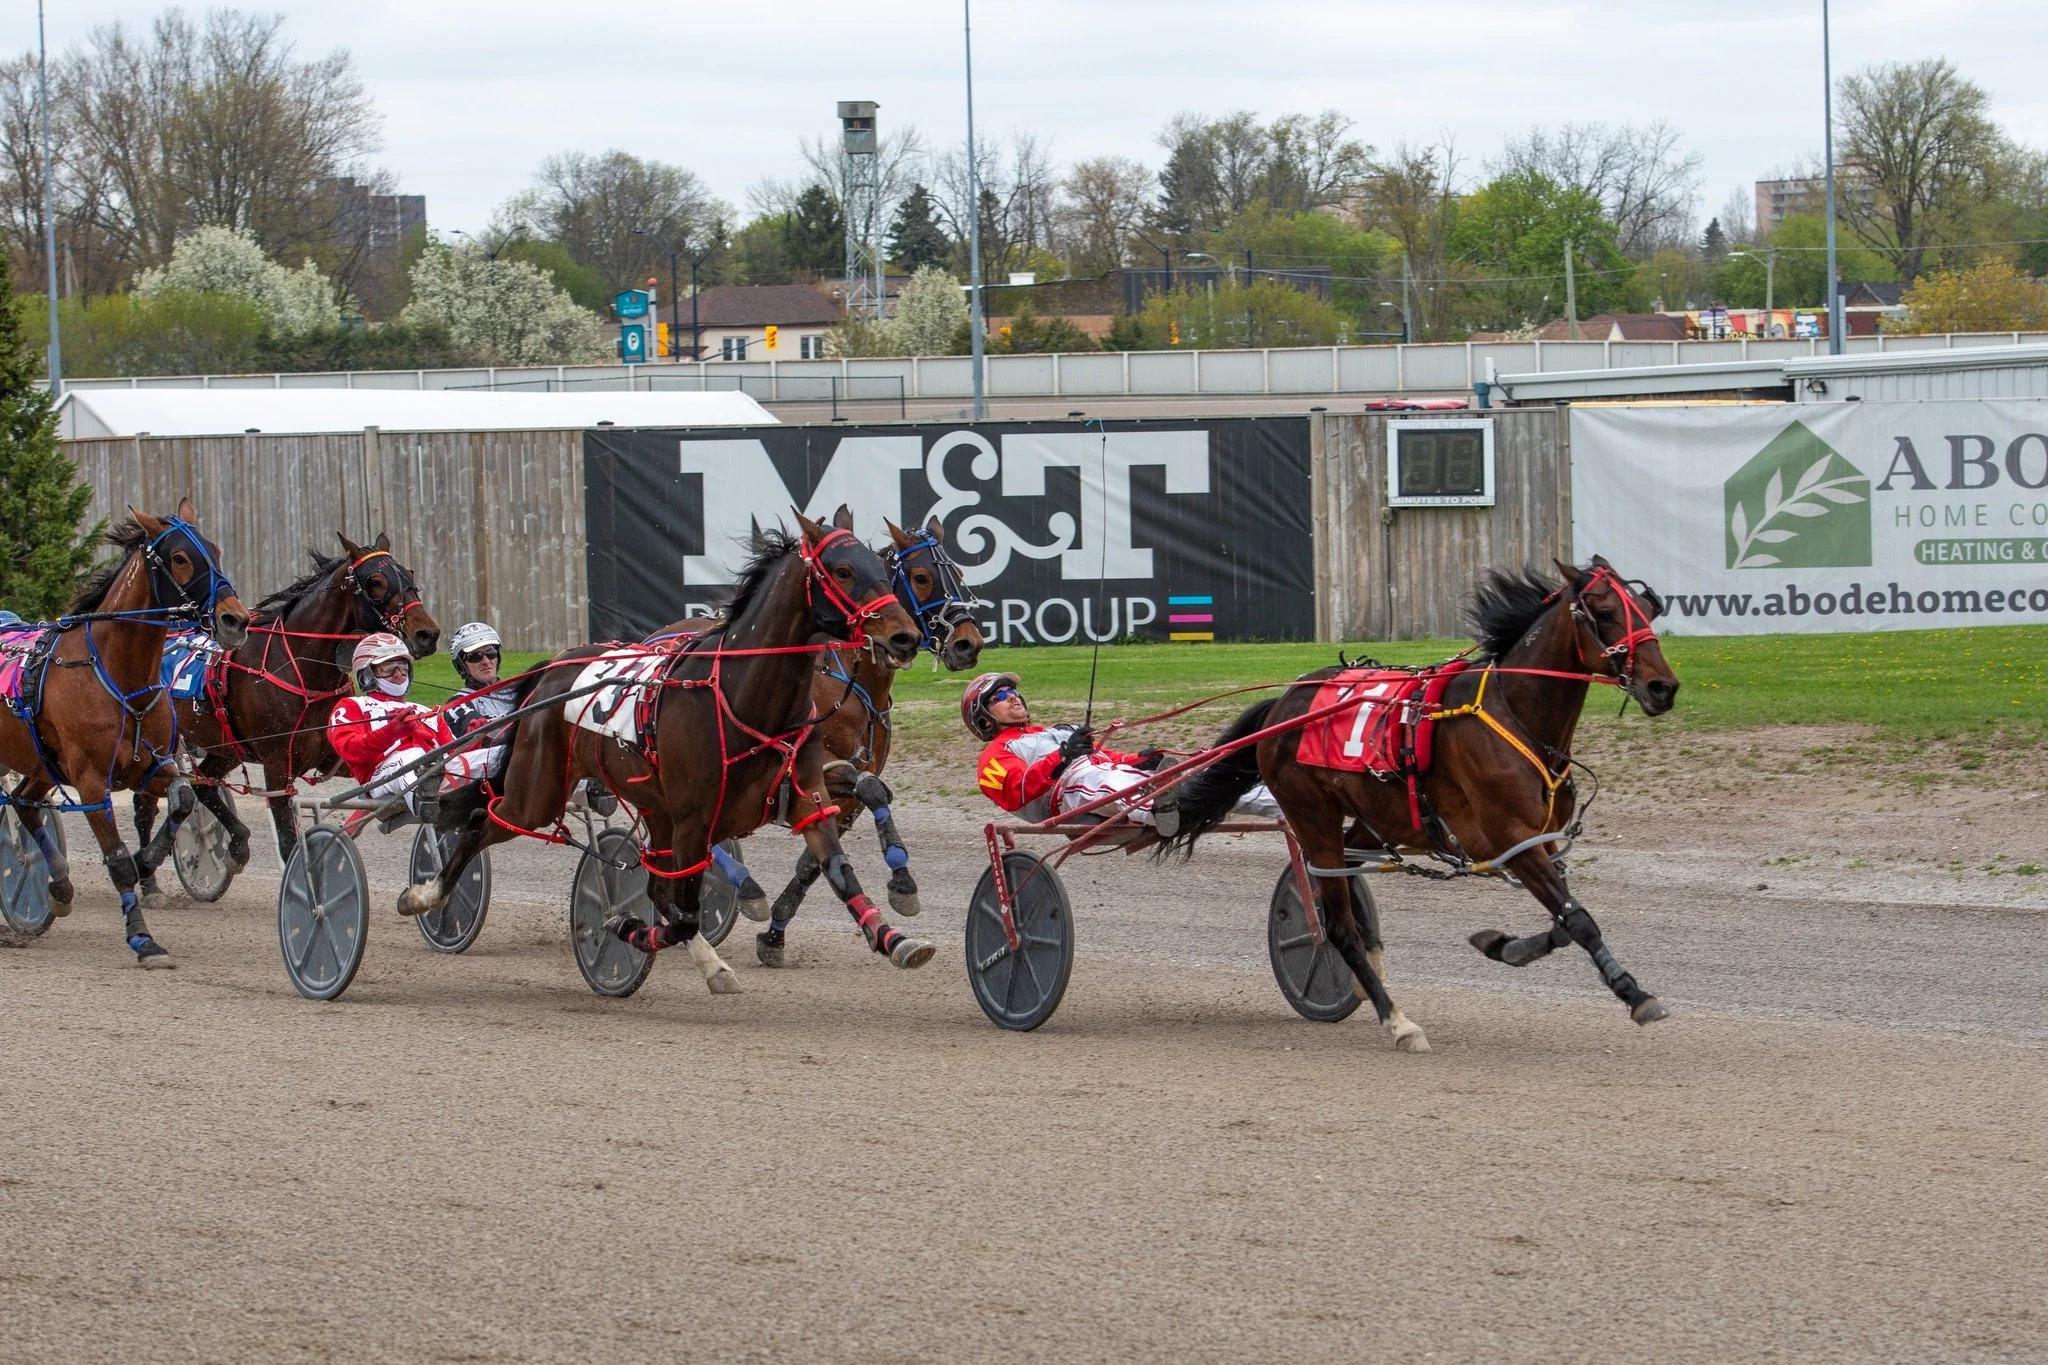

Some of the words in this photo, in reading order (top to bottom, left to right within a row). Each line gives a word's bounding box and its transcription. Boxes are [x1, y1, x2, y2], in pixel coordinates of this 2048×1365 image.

[1875, 433, 2048, 490] ABO
[680, 430, 1210, 586] M&T
[1895, 504, 1988, 527] HOME
[2009, 503, 2048, 526] CO
[1922, 541, 2014, 561] HEATING
[2021, 541, 2036, 560] &
[331, 707, 352, 732] R
[1343, 683, 1389, 757] 1
[978, 756, 1008, 790] W
